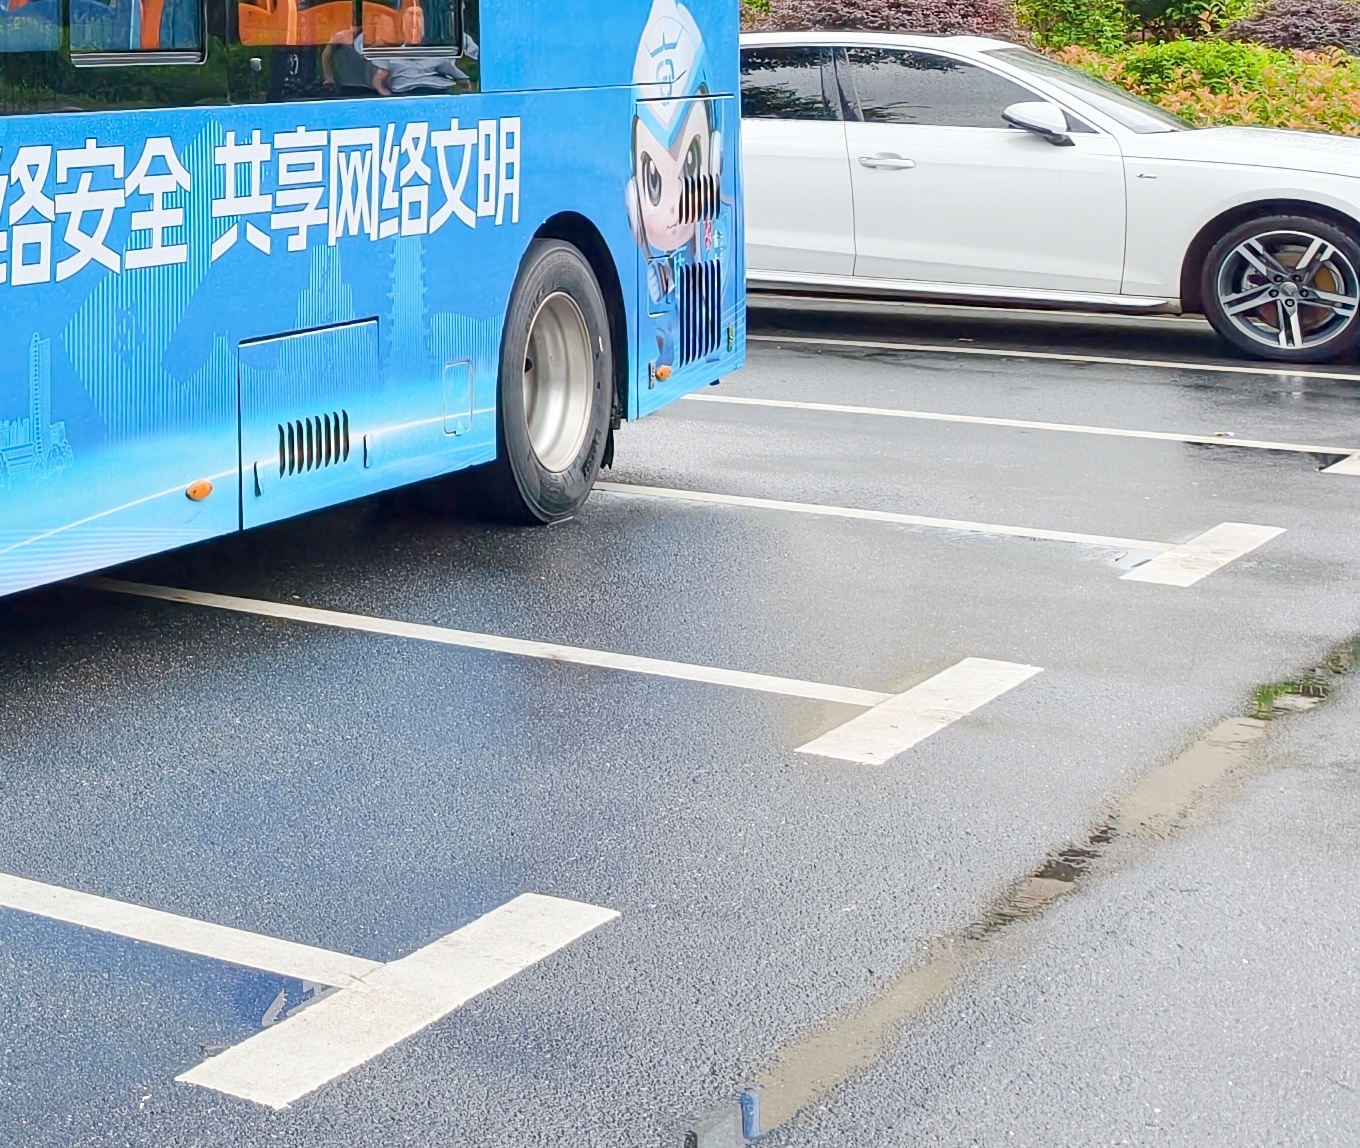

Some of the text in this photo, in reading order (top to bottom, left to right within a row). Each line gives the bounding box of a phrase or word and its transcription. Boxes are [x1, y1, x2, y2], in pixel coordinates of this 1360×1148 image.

[211, 117, 521, 262] 共享网络文明
